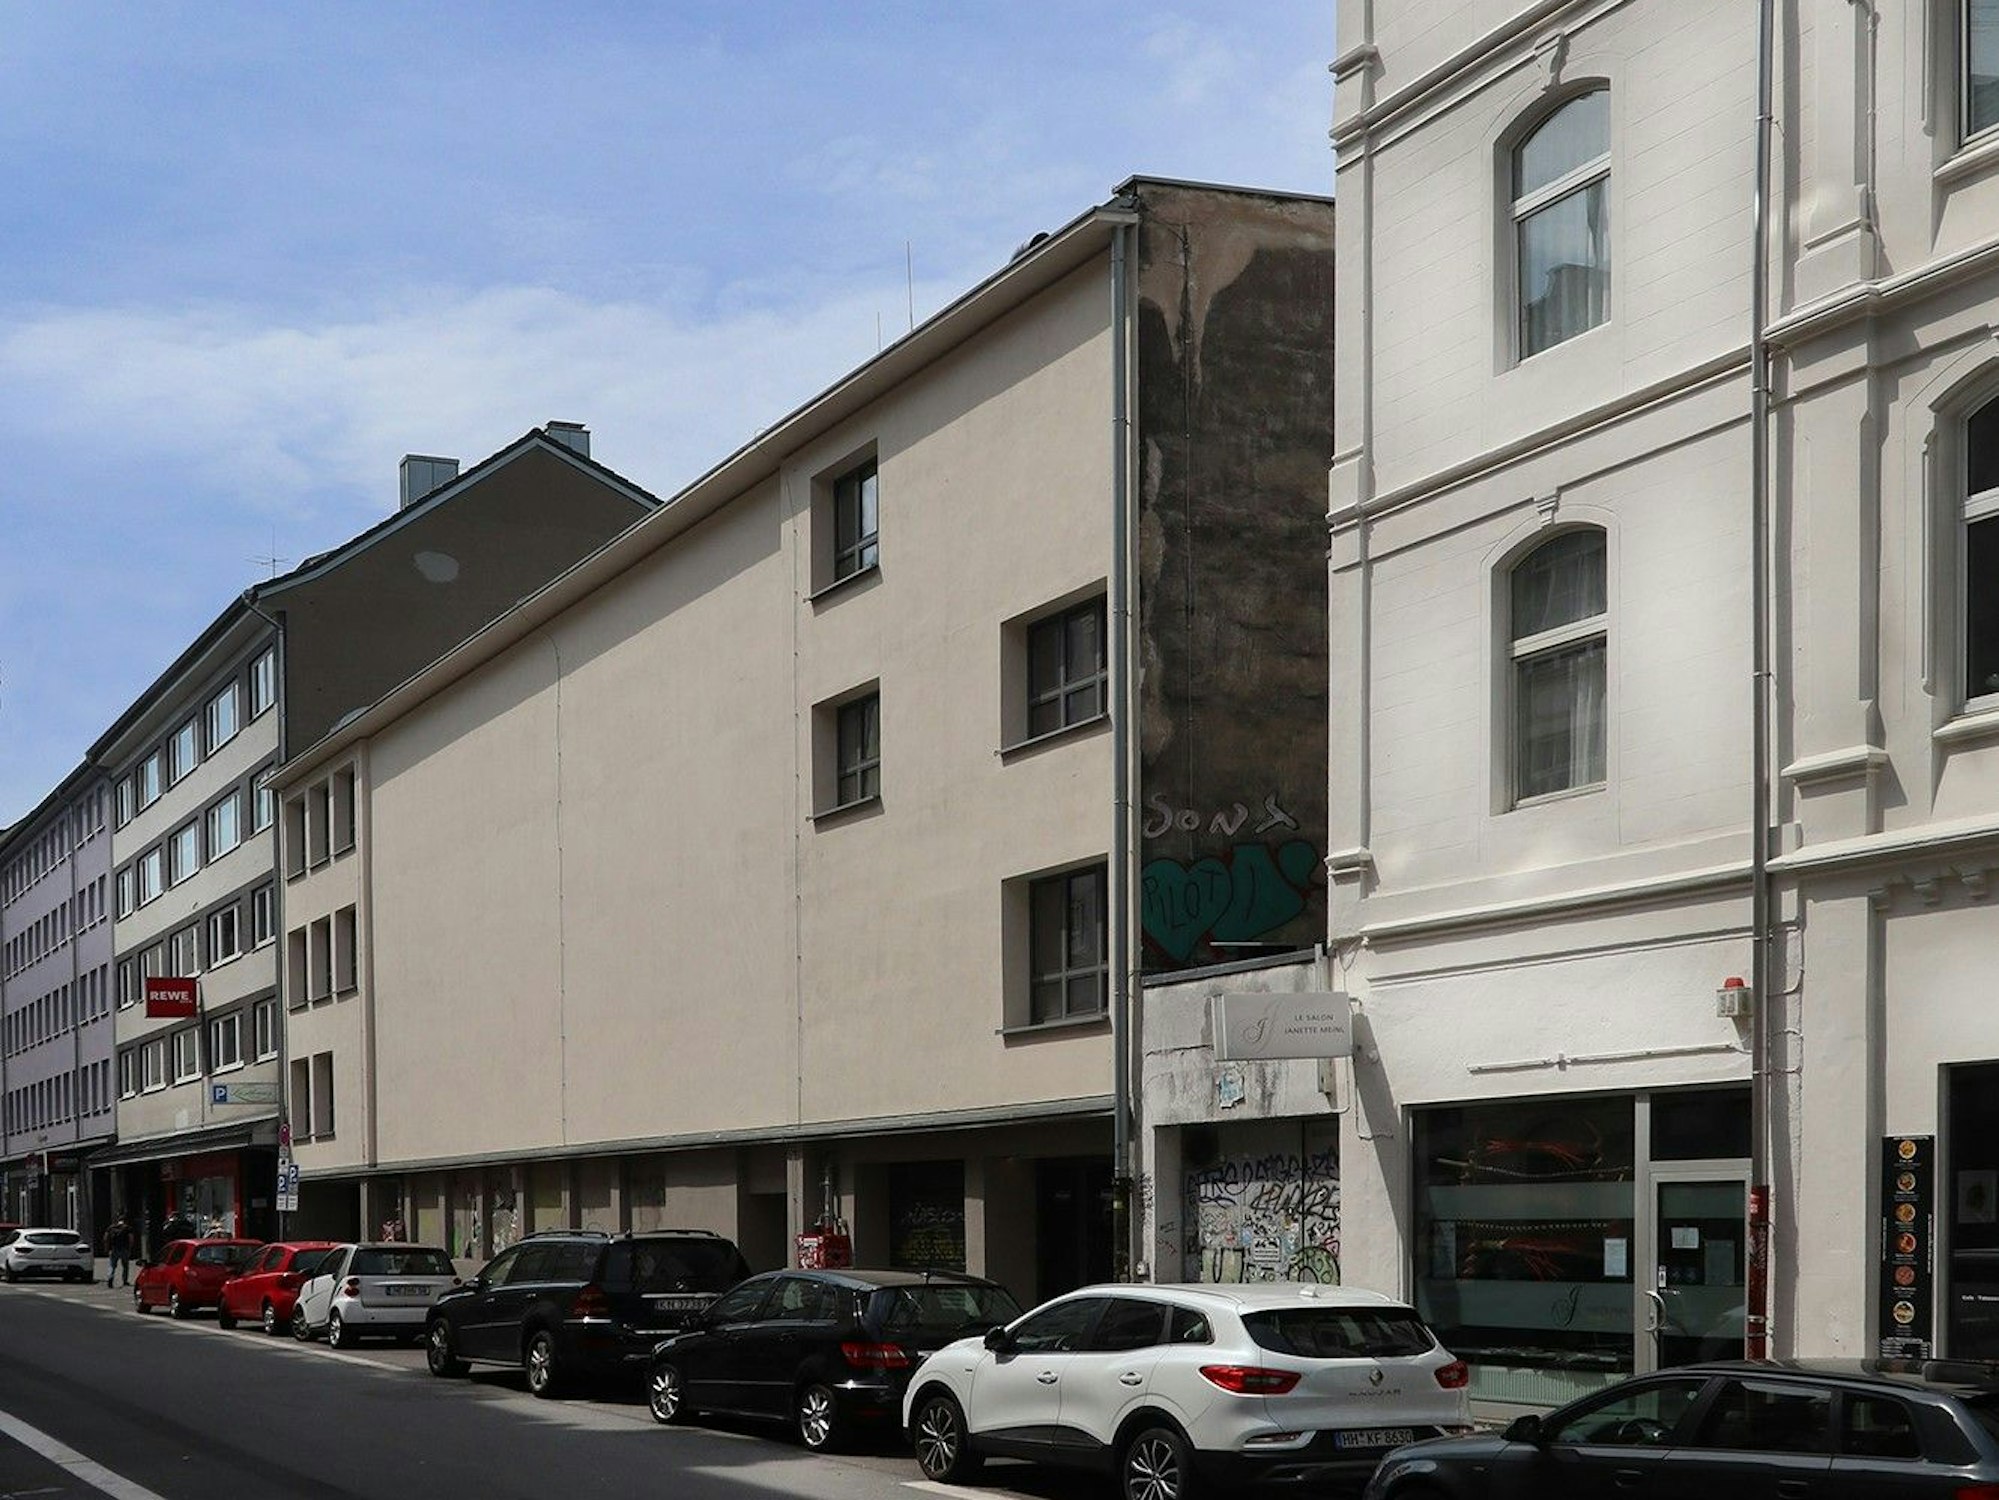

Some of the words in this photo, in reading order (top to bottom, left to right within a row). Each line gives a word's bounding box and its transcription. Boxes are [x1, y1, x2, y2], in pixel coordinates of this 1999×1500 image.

[149, 990, 189, 1001] REWE
[1305, 1013, 1334, 1021] SALON
[215, 1087, 226, 1100] P
[1343, 1433, 1358, 1445] HH
[1366, 1432, 1382, 1445] KF
